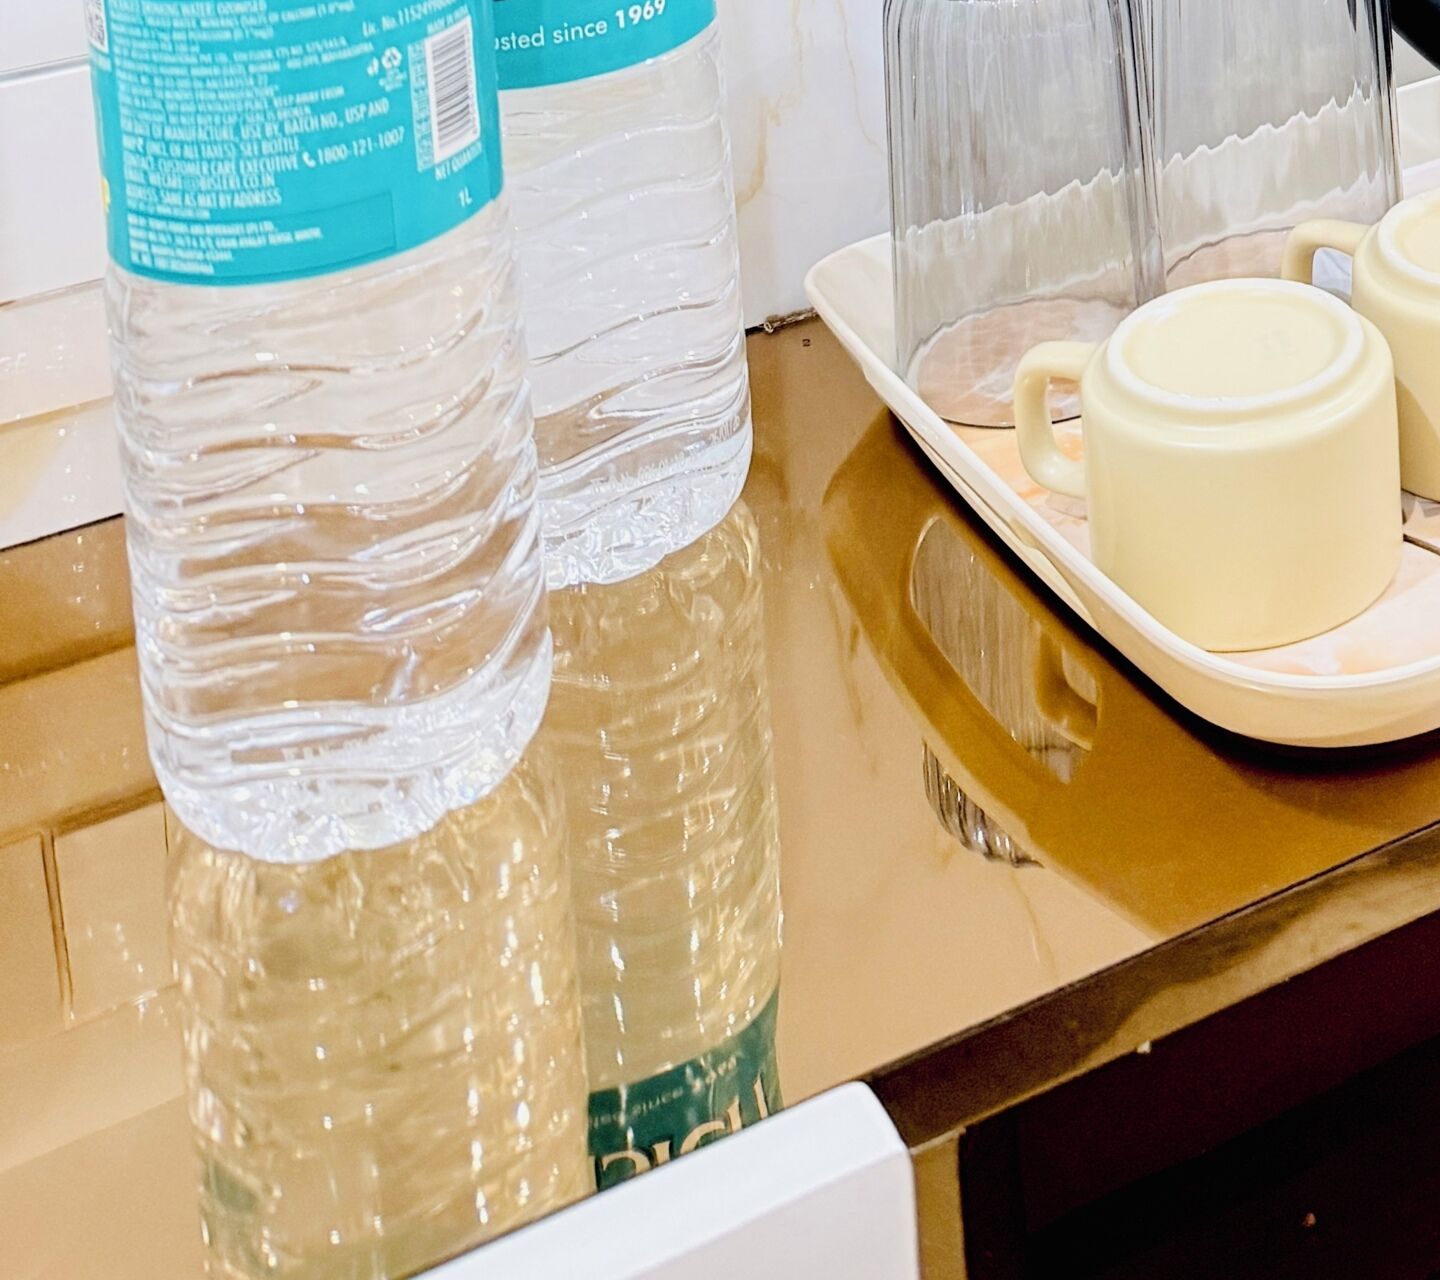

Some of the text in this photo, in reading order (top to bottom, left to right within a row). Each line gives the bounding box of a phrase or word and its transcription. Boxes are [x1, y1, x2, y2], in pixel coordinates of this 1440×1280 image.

[494, 26, 545, 54] sted
[553, 19, 607, 45] since
[344, 103, 367, 124] USP
[368, 96, 389, 117] AND
[317, 125, 405, 165] 1800-121-1007
[234, 187, 282, 208] ADDRESS
